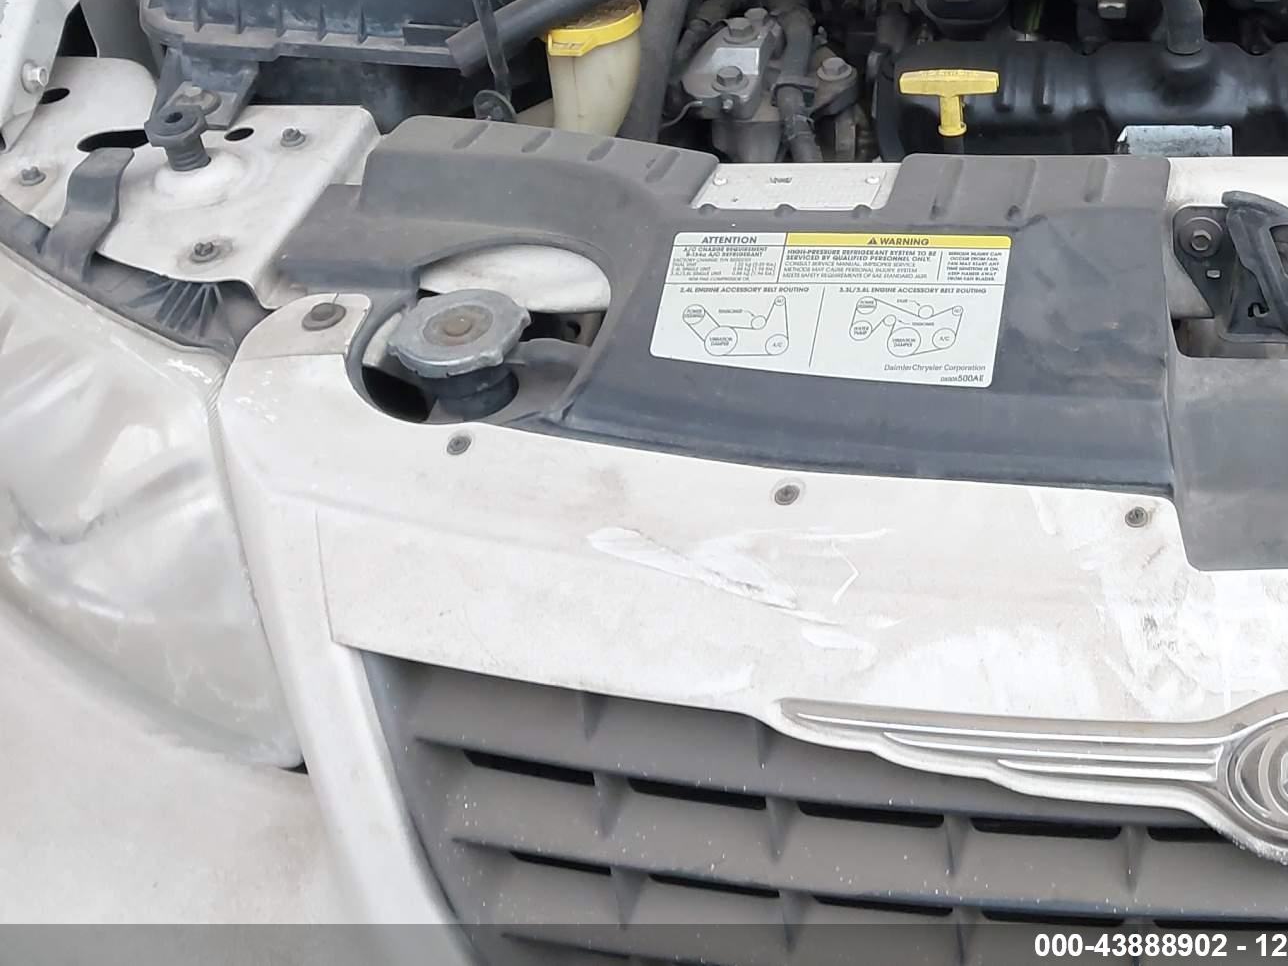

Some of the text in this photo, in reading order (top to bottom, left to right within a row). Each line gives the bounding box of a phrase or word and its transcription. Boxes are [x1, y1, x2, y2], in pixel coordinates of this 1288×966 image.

[701, 236, 757, 244] ATTENTION
[879, 237, 930, 246] WARNING
[884, 363, 986, 373] DaimlerChrysler Corporation
